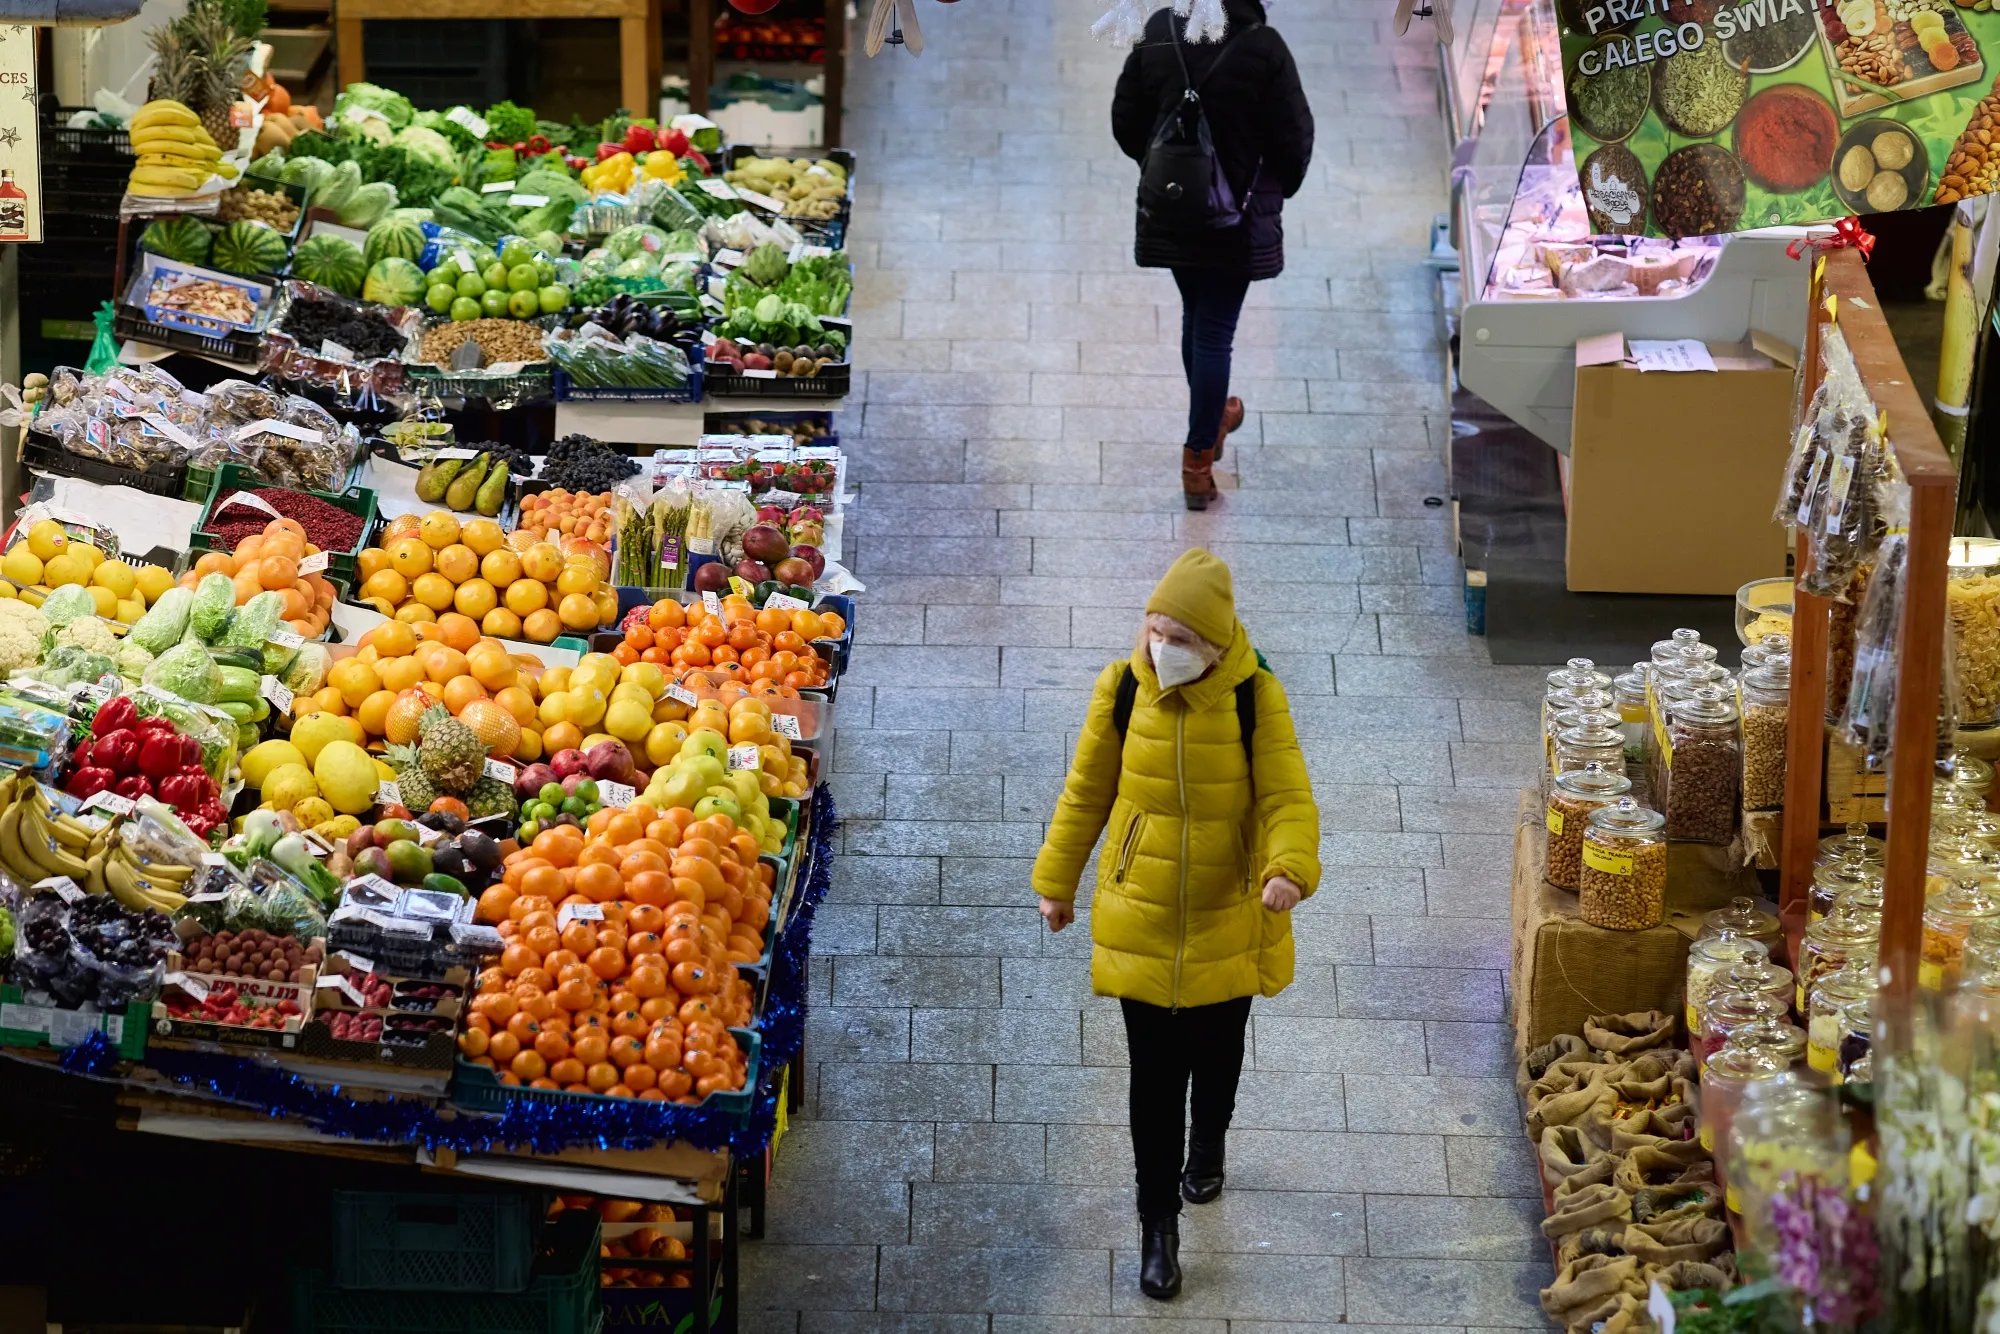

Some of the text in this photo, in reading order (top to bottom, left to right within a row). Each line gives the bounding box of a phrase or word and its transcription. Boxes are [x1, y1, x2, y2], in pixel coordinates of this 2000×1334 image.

[1579, 0, 1833, 75] CAŁEGO ŚWIA
[0, 73, 28, 84] CES
